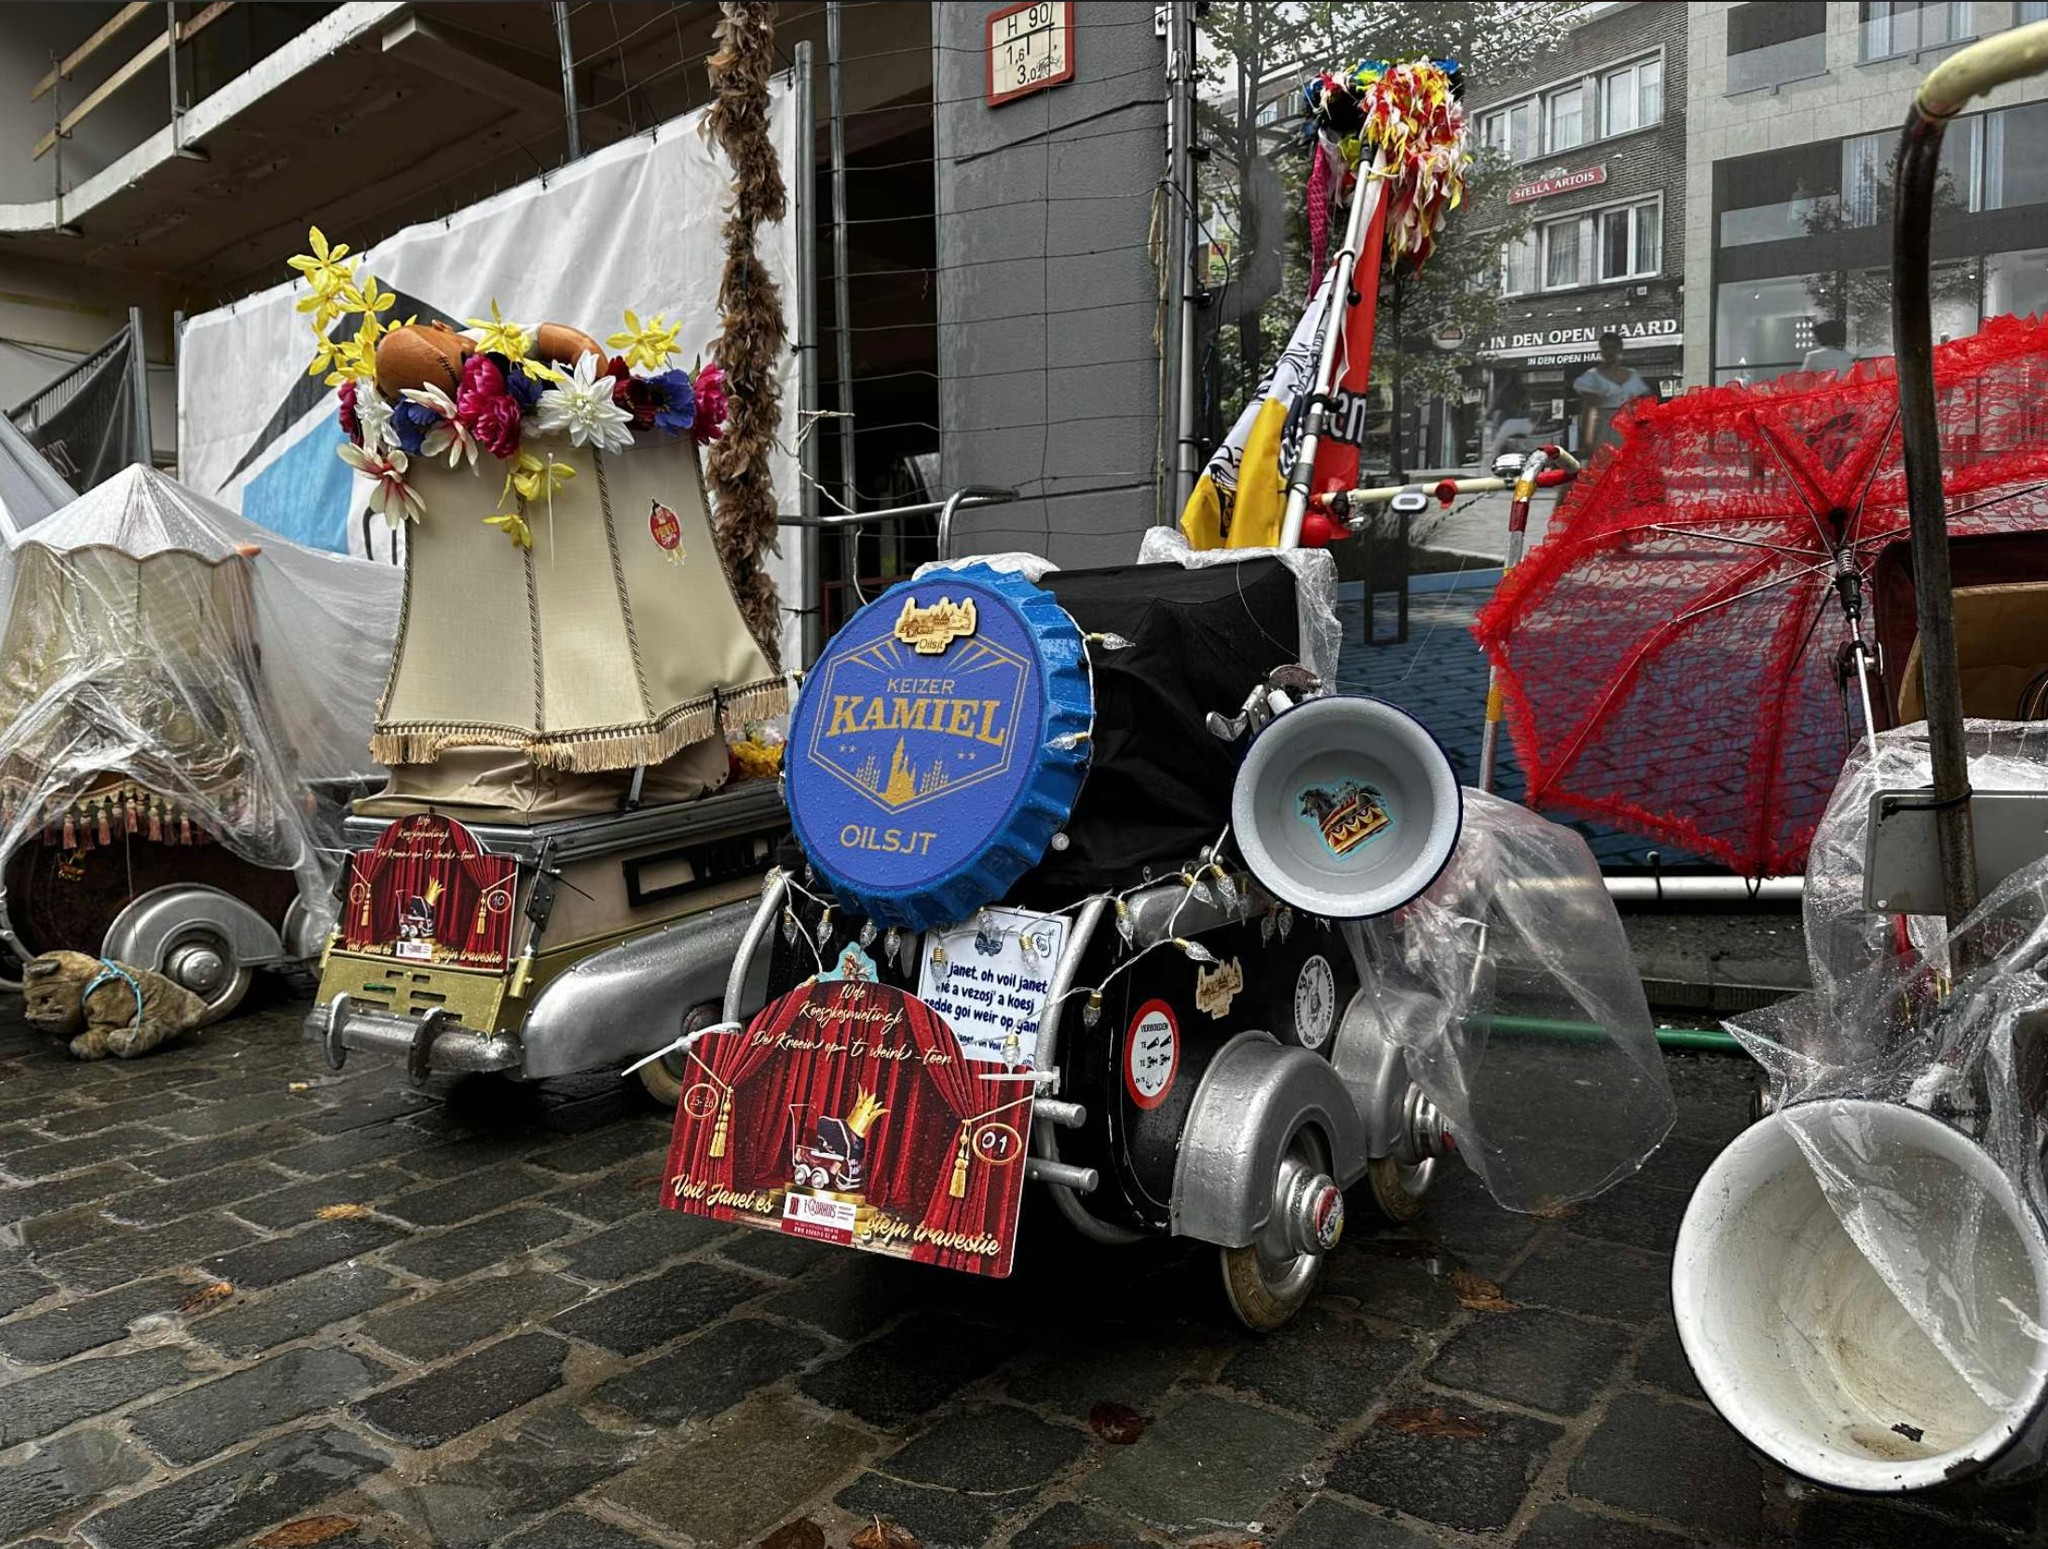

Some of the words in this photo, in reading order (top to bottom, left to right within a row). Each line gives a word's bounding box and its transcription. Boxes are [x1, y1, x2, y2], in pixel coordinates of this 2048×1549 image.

[1007, 14, 1018, 37] H
[1028, 2, 1049, 28] 90
[1514, 182, 1551, 199] STELLA
[1554, 171, 1595, 189] ARTOIS
[1489, 334, 1507, 350] IN
[1511, 331, 1544, 348] DEN
[1549, 326, 1596, 344] OPEN
[1536, 352, 1557, 366] DEN
[1556, 351, 1581, 365] OPEN
[919, 638, 945, 651] Oilsjt
[886, 677, 956, 695] KEIZER
[824, 695, 1007, 747] KAMIEL
[840, 823, 937, 856] OILSJT
[837, 982, 866, 1001] 10de
[981, 968, 995, 984] oh
[997, 972, 1017, 988] voil
[1015, 975, 1048, 995] janet
[952, 984, 959, 996] a
[997, 993, 1005, 1006] a
[1007, 993, 1035, 1016] koesj
[953, 1004, 972, 1021] goi
[973, 1007, 999, 1024] weir
[1000, 1015, 1014, 1032] op
[670, 1173, 707, 1199] Voil
[707, 1182, 758, 1210] Janet
[756, 1198, 775, 1215] es
[912, 1219, 1002, 1257] travestie
